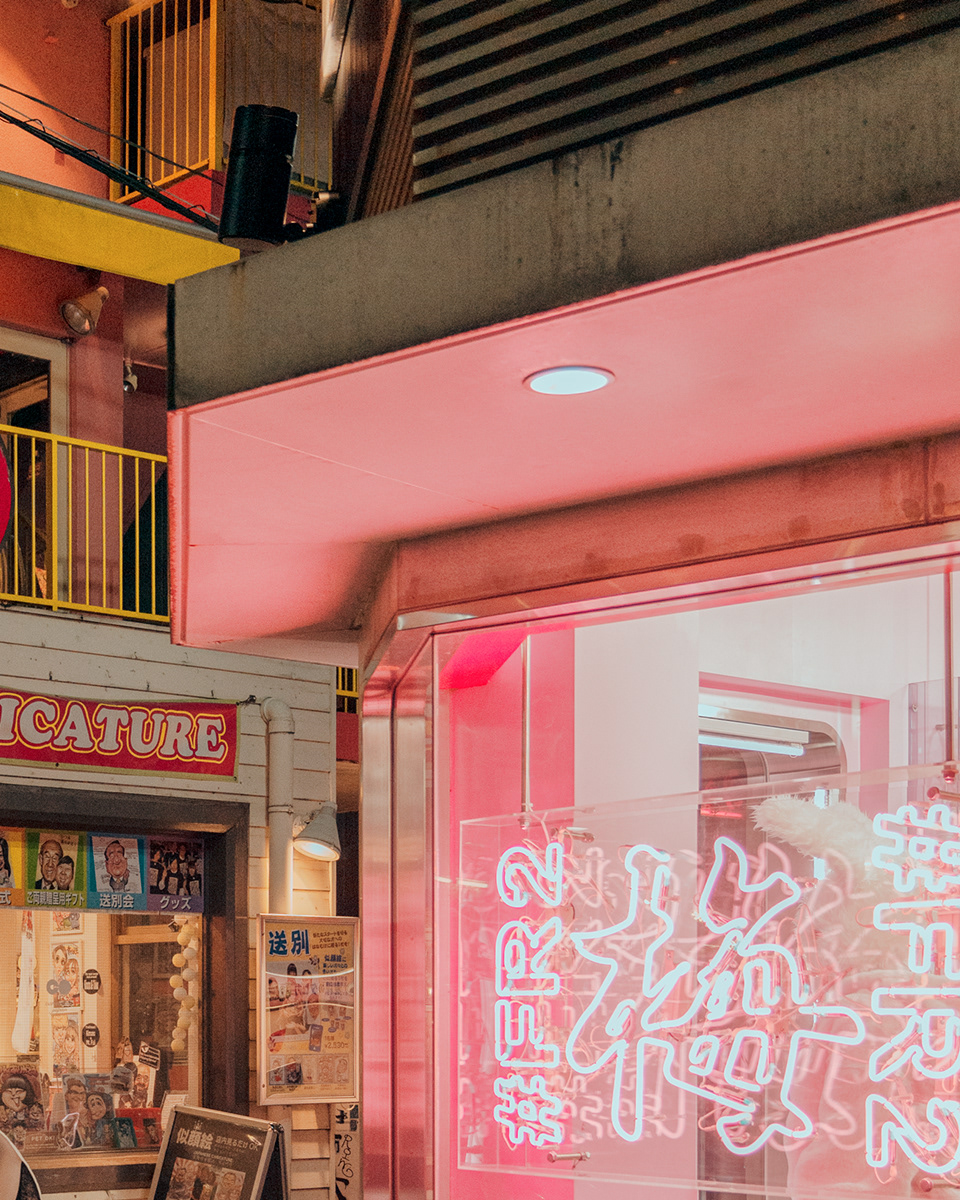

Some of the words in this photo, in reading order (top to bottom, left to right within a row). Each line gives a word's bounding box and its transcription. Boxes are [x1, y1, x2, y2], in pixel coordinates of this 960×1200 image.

[98, 893, 135, 908] 送別会
[159, 896, 192, 911] グッズ
[268, 929, 310, 955] 送別
[493, 842, 564, 1147] #FR2
[865, 803, 960, 1174] #FR2
[176, 1127, 214, 1151] 似顔絵
